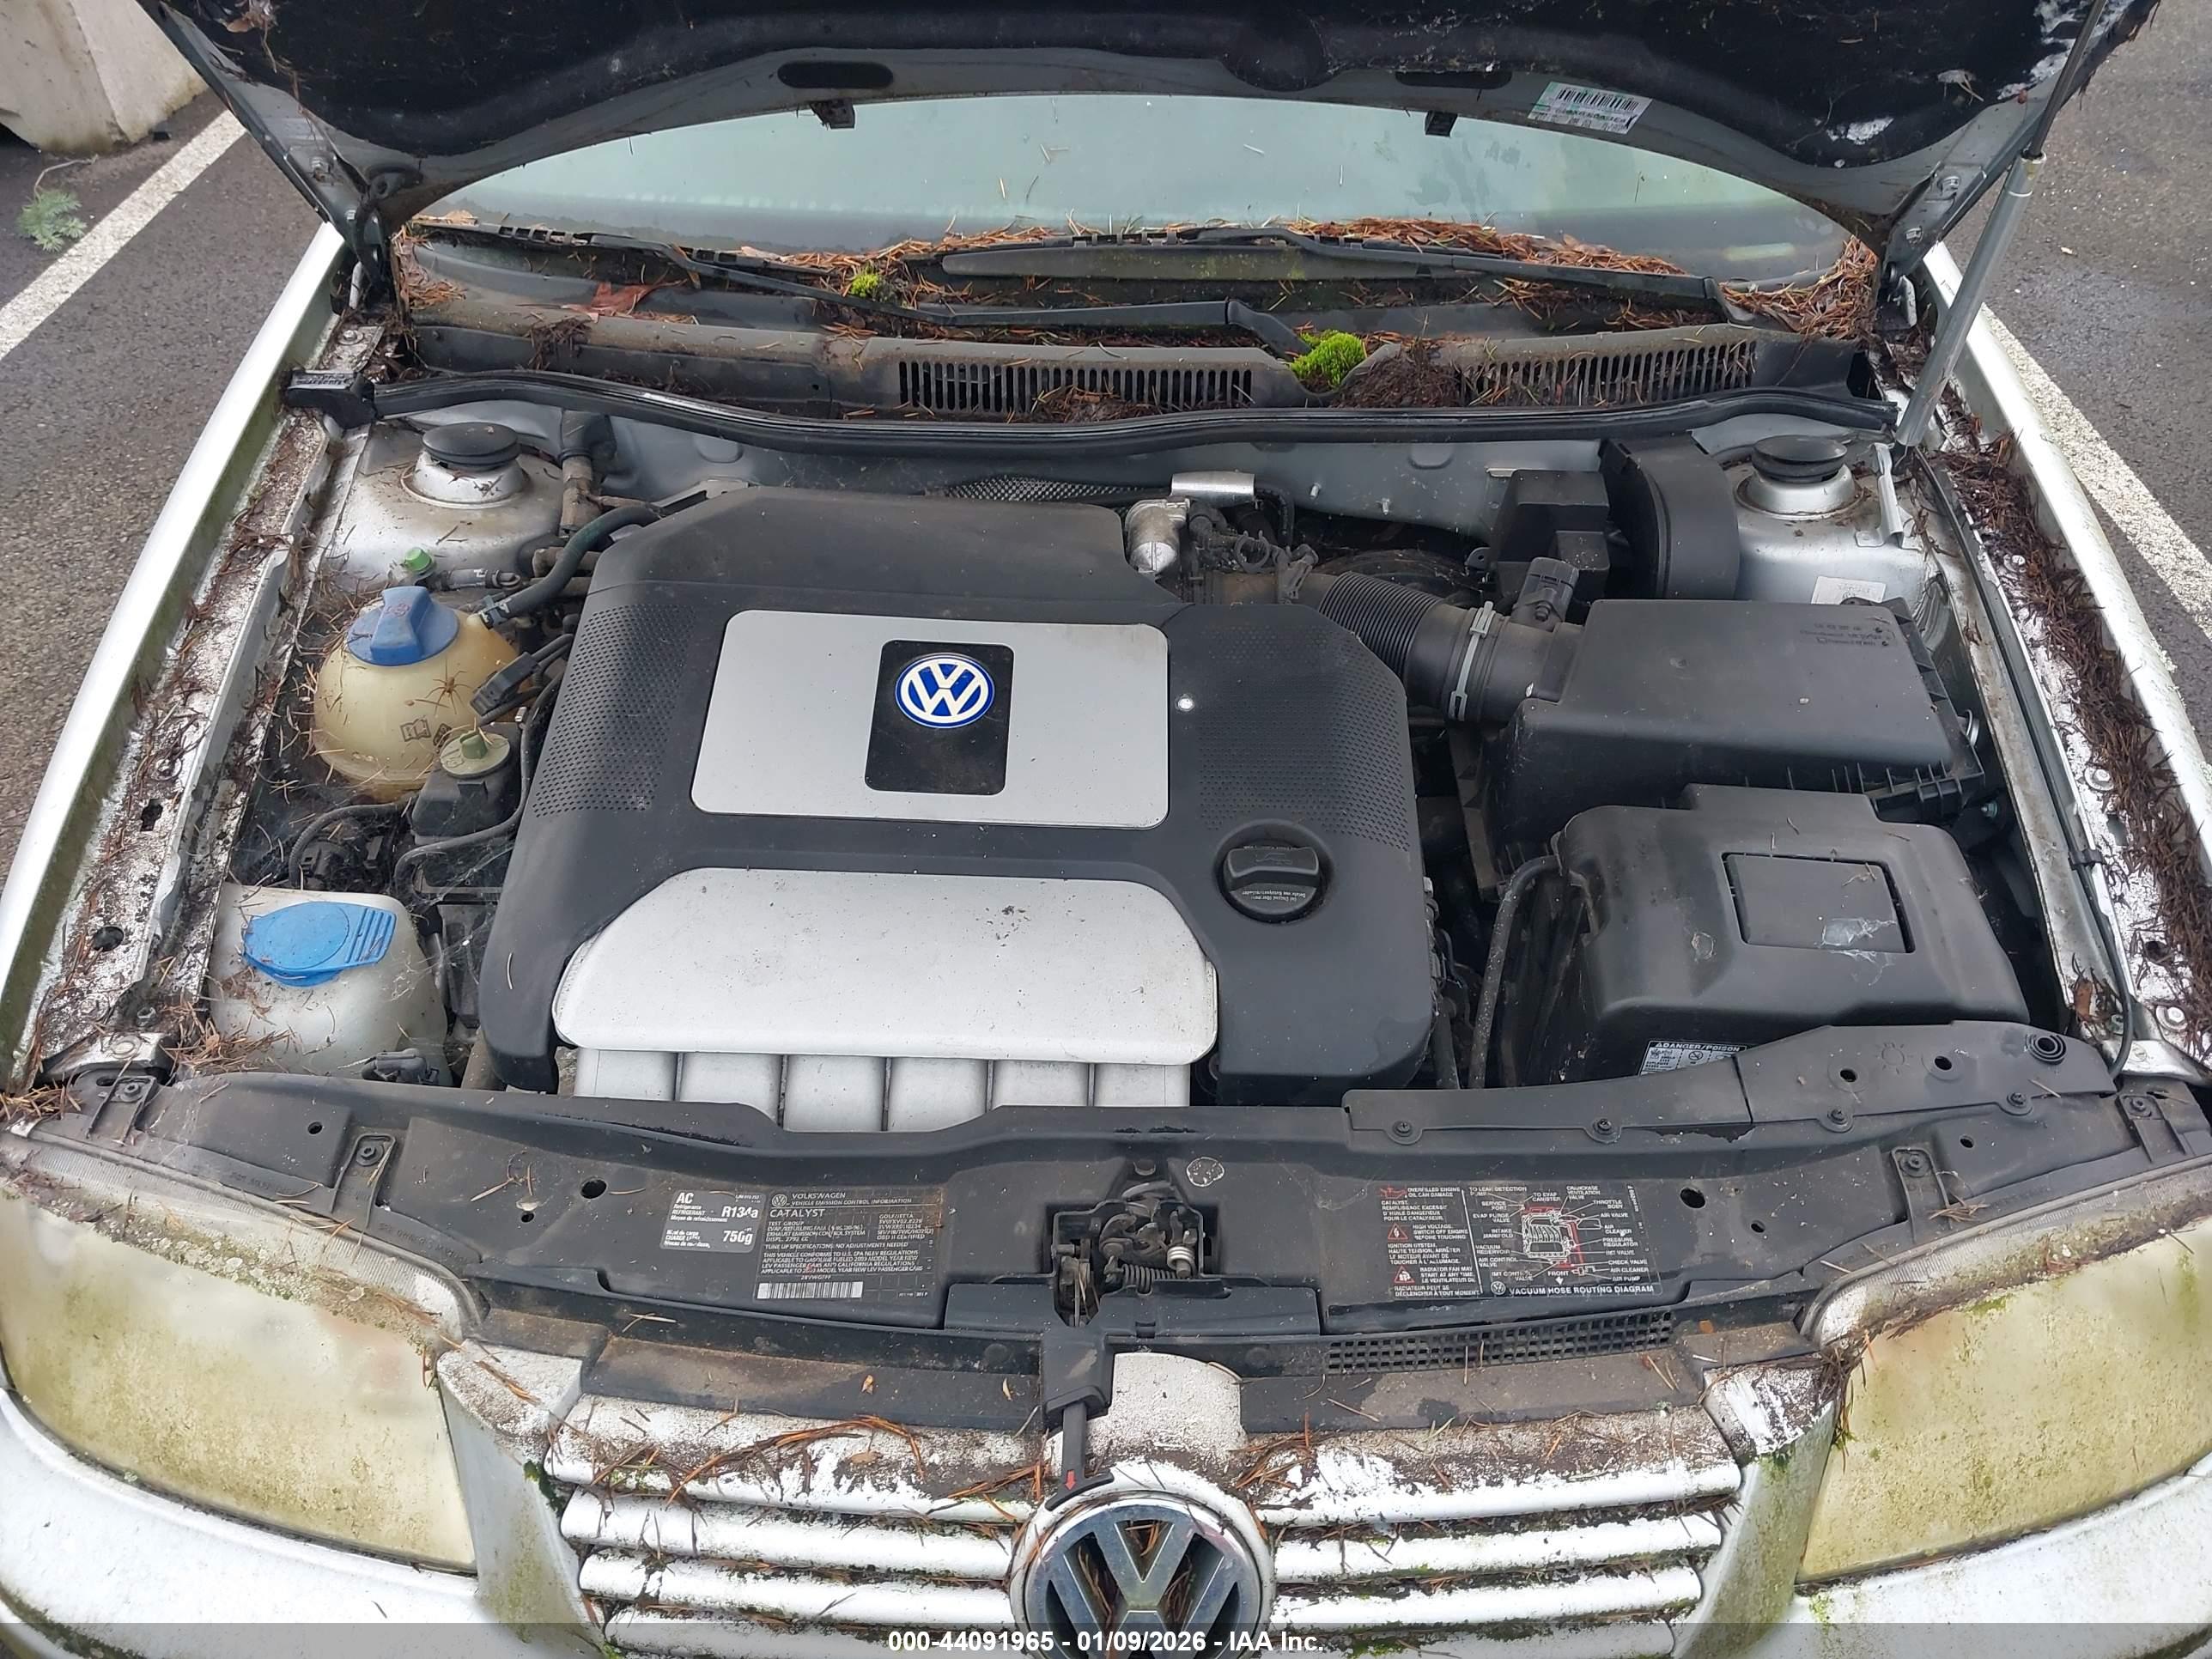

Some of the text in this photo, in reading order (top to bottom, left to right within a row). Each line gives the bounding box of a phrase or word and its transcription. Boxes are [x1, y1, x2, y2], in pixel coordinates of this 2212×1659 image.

[1663, 1042, 1740, 1052] DANGER/POISON
[676, 1193, 694, 1204] AC
[721, 1206, 759, 1218] R134a
[769, 1209, 825, 1218] CATALYST
[723, 1230, 753, 1245] 750g
